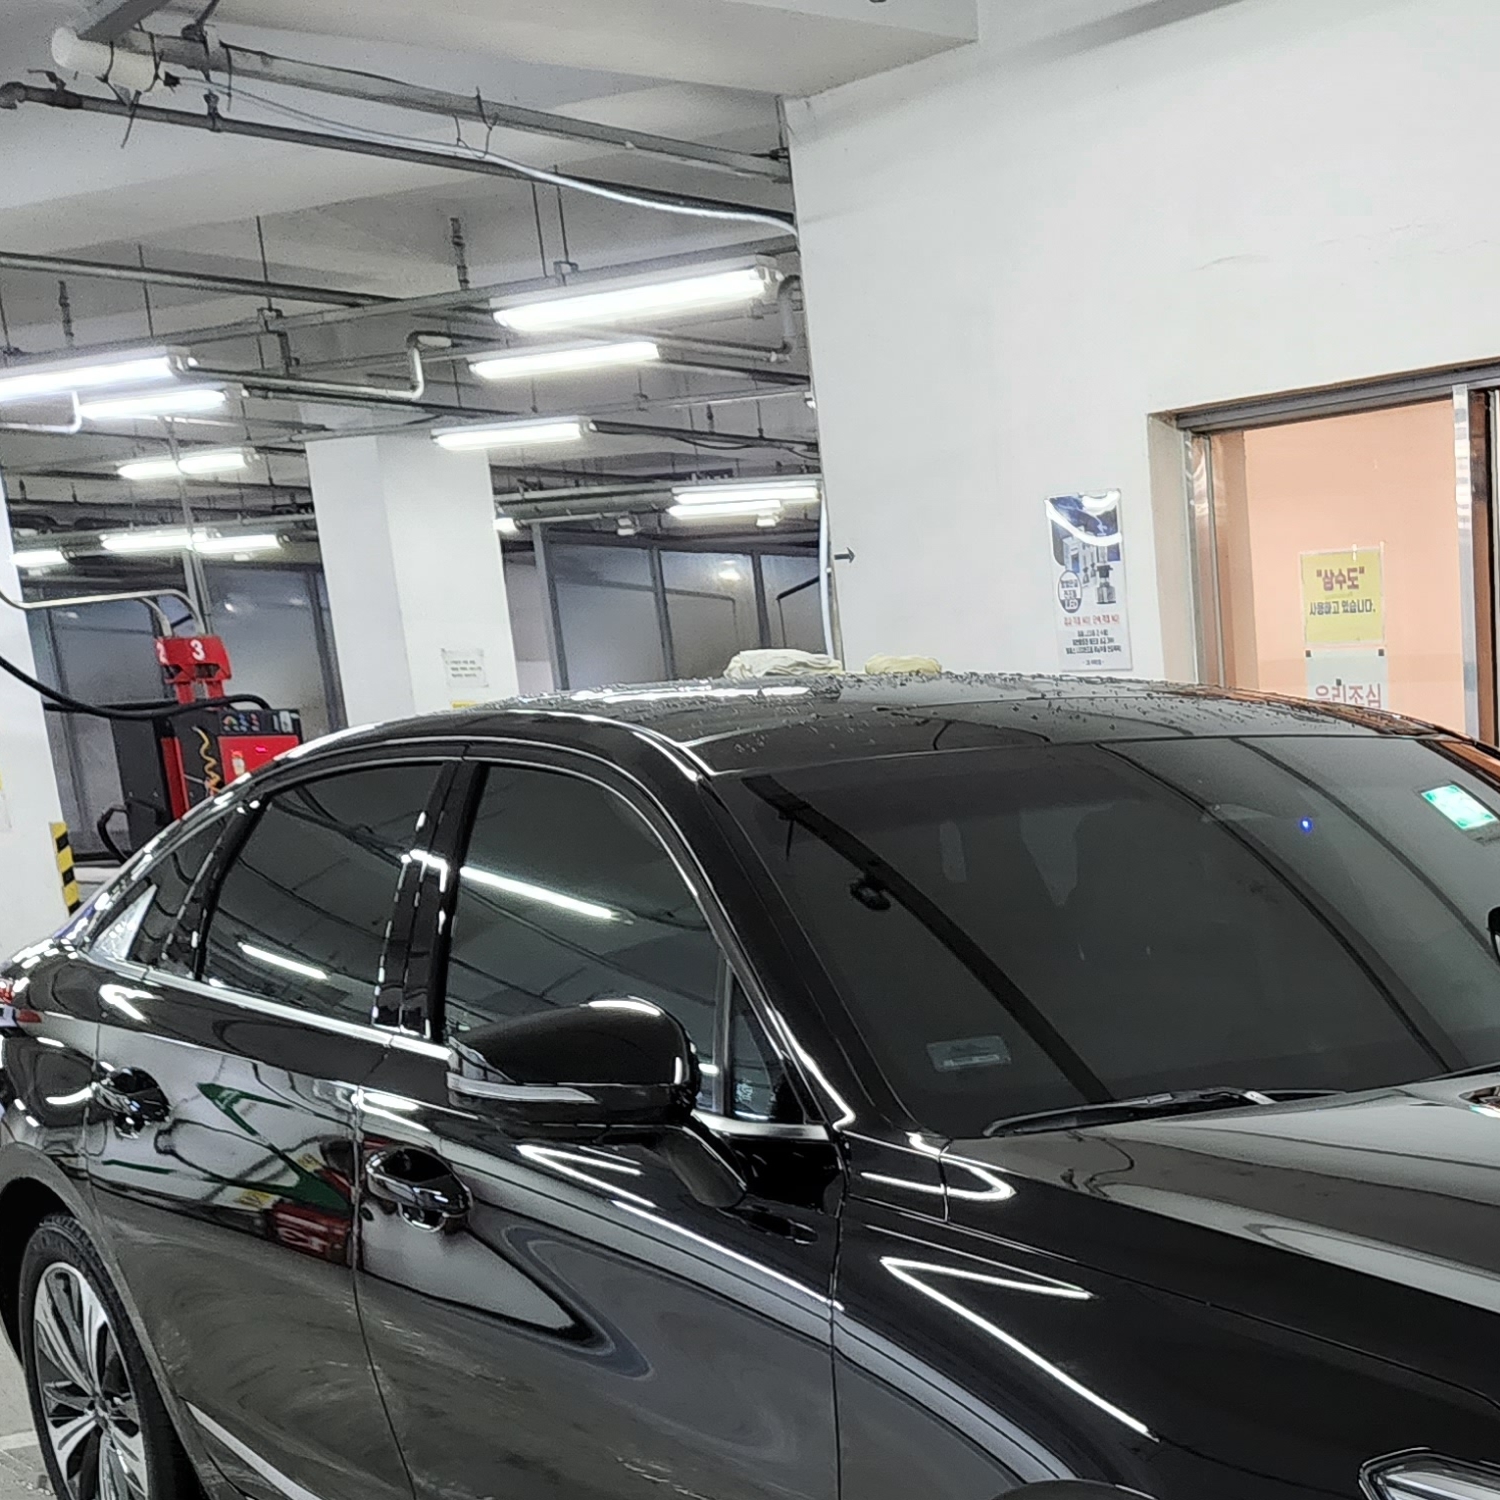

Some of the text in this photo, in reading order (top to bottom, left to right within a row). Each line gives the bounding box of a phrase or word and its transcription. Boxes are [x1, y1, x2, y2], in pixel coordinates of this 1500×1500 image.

[1309, 599, 1376, 615] 사용하고 있습니다.
[190, 639, 206, 661] 3
